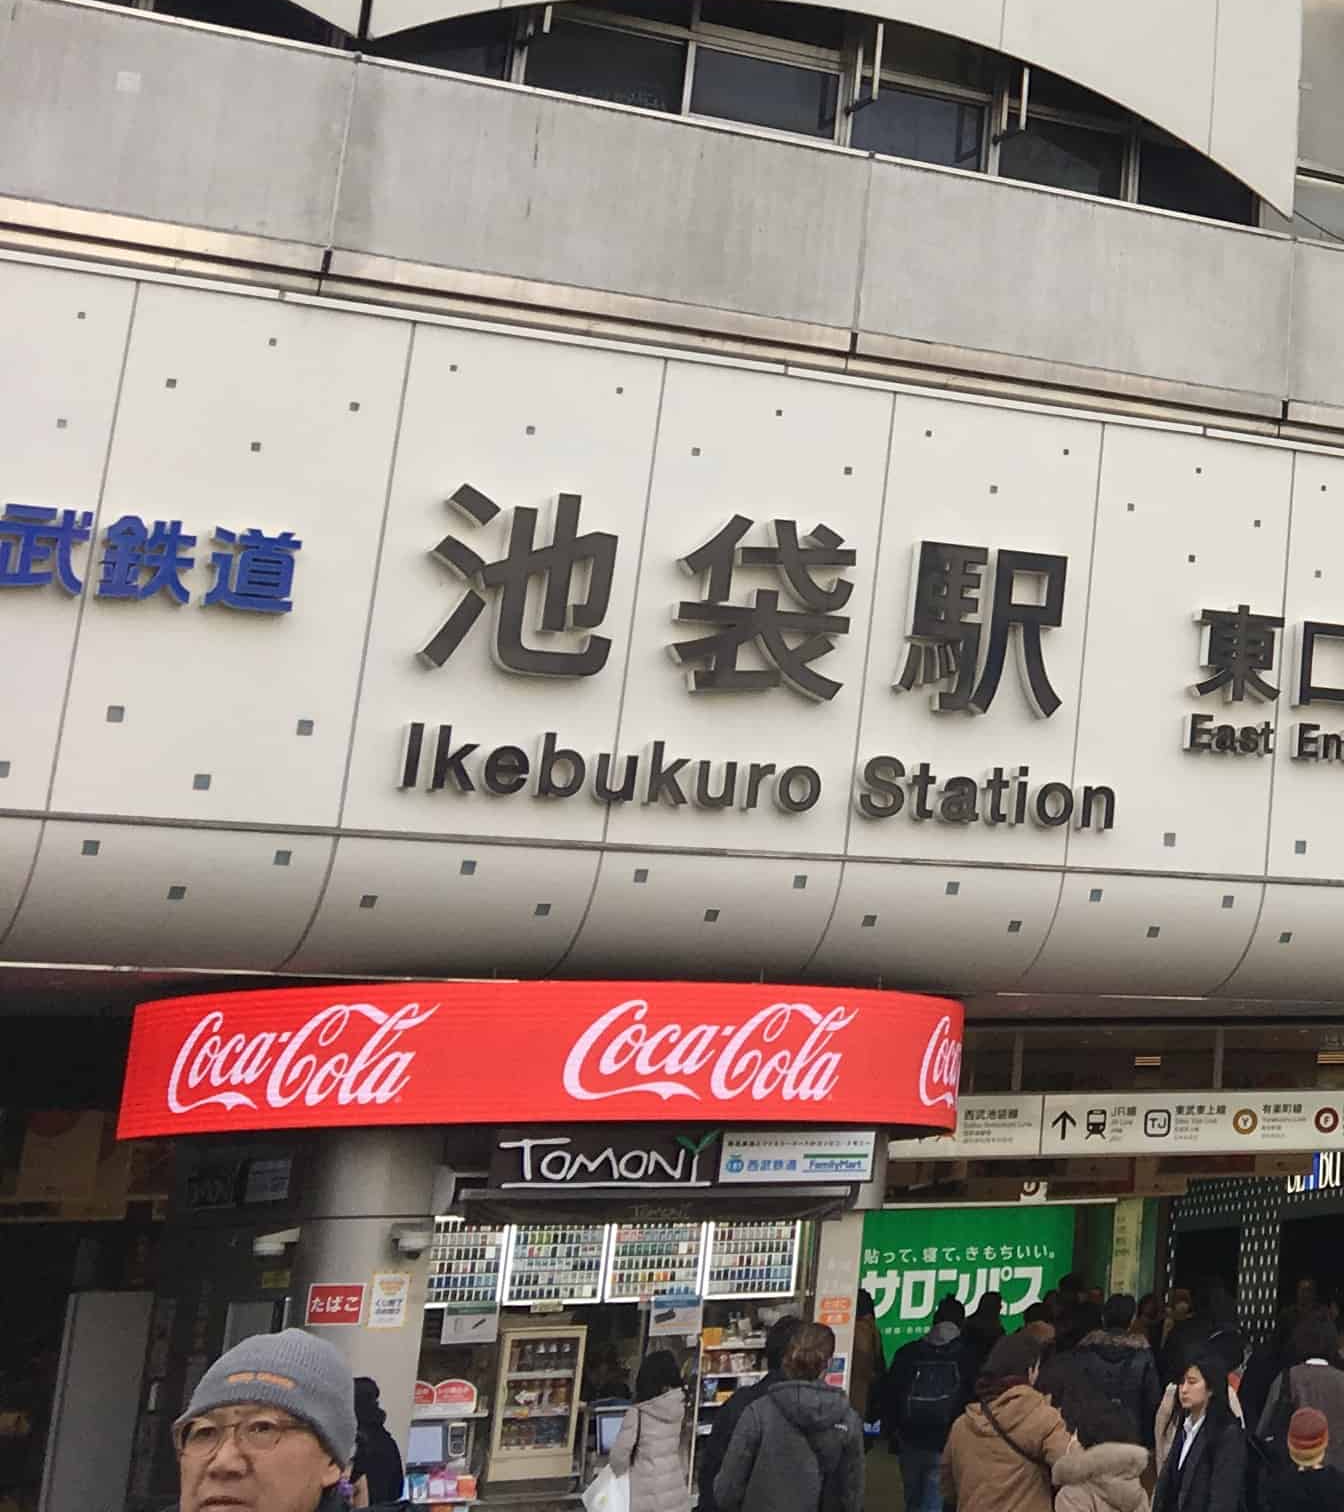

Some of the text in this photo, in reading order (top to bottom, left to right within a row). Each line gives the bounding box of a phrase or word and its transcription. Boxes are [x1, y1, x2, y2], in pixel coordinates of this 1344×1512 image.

[414, 483, 1068, 719] 池袋駅
[400, 721, 1117, 831] Ikebukuro Station
[1183, 713, 1275, 758] East
[167, 1003, 441, 1113] Coca-Cola
[562, 998, 859, 1103] Coca-Cola
[808, 1159, 864, 1175] FamilyMart
[310, 1295, 360, 1313] たばこ
